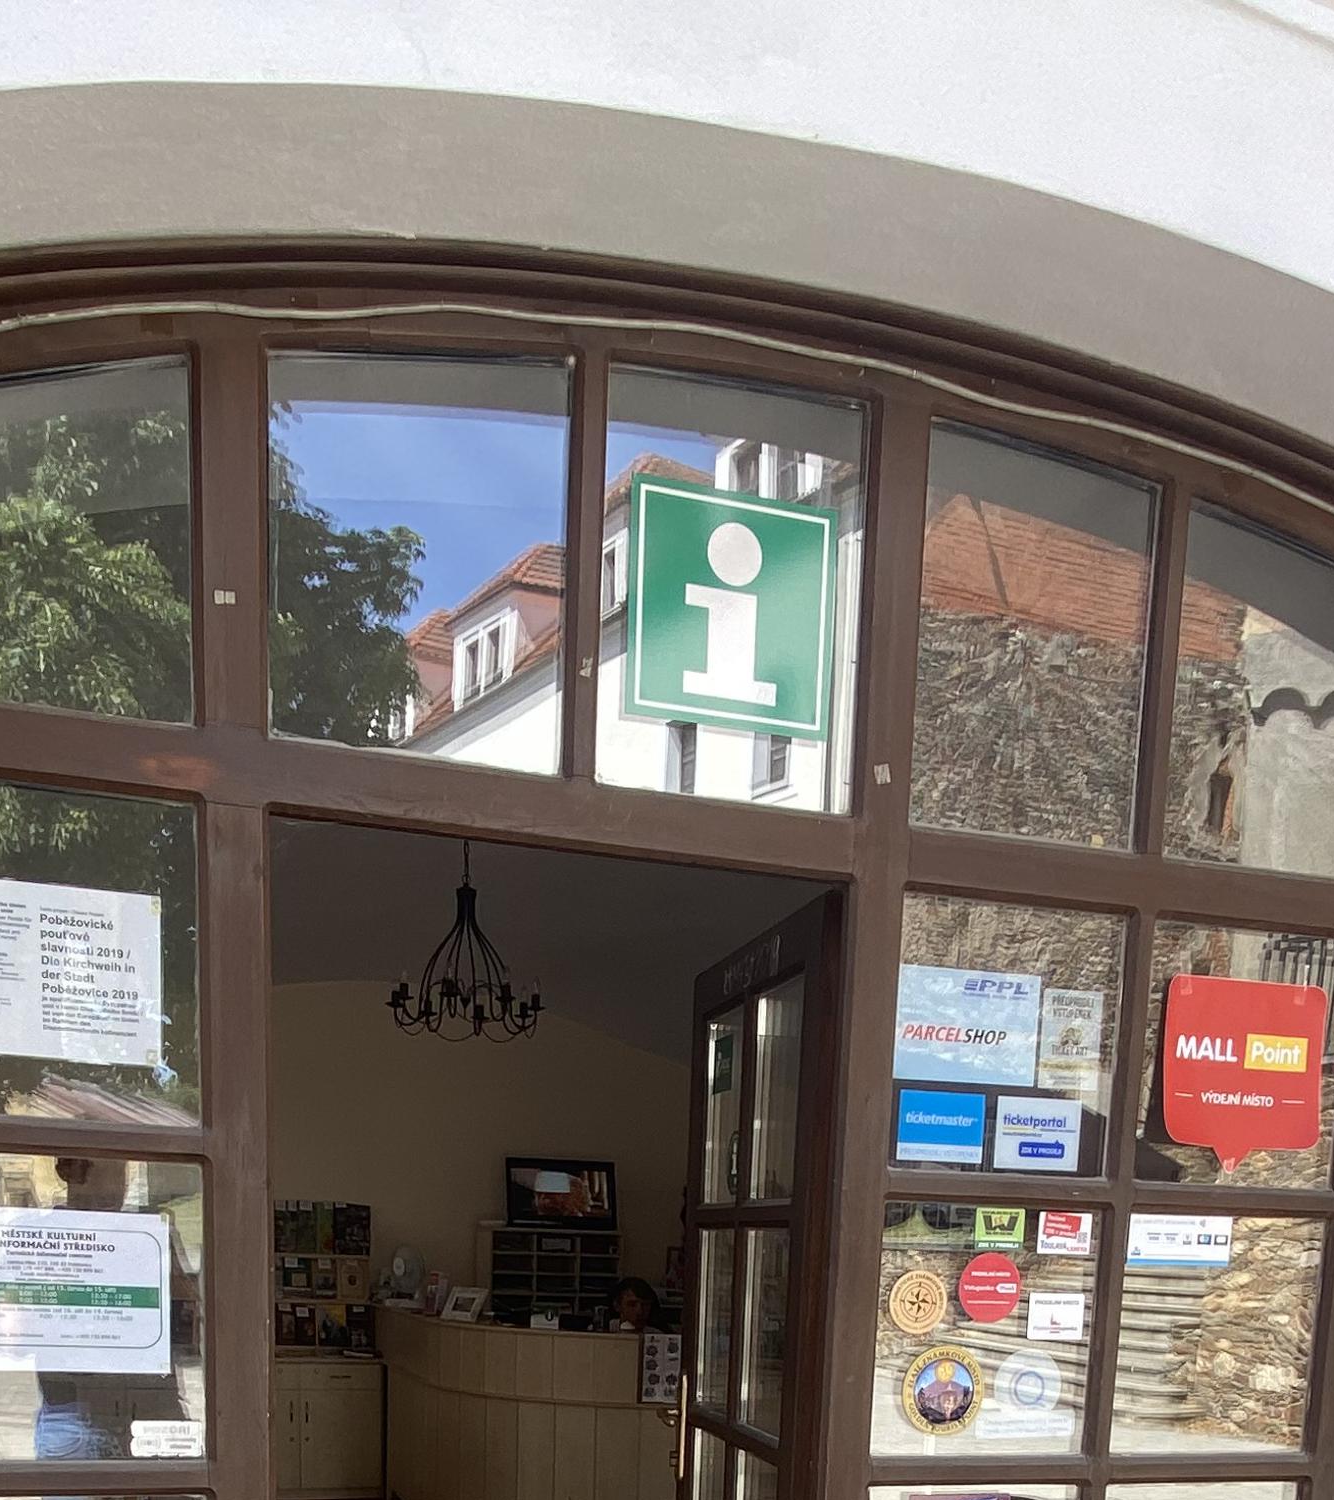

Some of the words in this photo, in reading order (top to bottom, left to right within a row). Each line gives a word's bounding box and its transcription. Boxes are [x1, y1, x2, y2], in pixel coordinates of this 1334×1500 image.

[40, 914, 114, 931] Poběžovické
[40, 929, 90, 942] pouťové
[41, 942, 94, 956] slavnosti
[97, 947, 124, 959] 2019
[41, 955, 60, 965] Die
[63, 957, 121, 972] Kirchweih
[124, 963, 135, 974] in
[41, 969, 61, 980] der
[63, 971, 95, 983] Stadt
[42, 983, 109, 998] Poběžovice
[112, 989, 138, 1000] 2019
[978, 979, 1029, 995] PPL
[902, 1023, 1008, 1046] PARCELSHOP
[1176, 1034, 1238, 1063] MALL
[1251, 1041, 1302, 1065] Point
[1200, 1089, 1241, 1106] VÝDEJNÍ
[1242, 1092, 1275, 1107] MÍSTO
[906, 1110, 974, 1127] ticketmaster
[1003, 1113, 1067, 1129] ticketportal
[1, 1229, 43, 1240] MĚSTSKÉ
[46, 1231, 97, 1242] KULTURNÍ
[63, 1242, 116, 1253] STŘEDISKO
